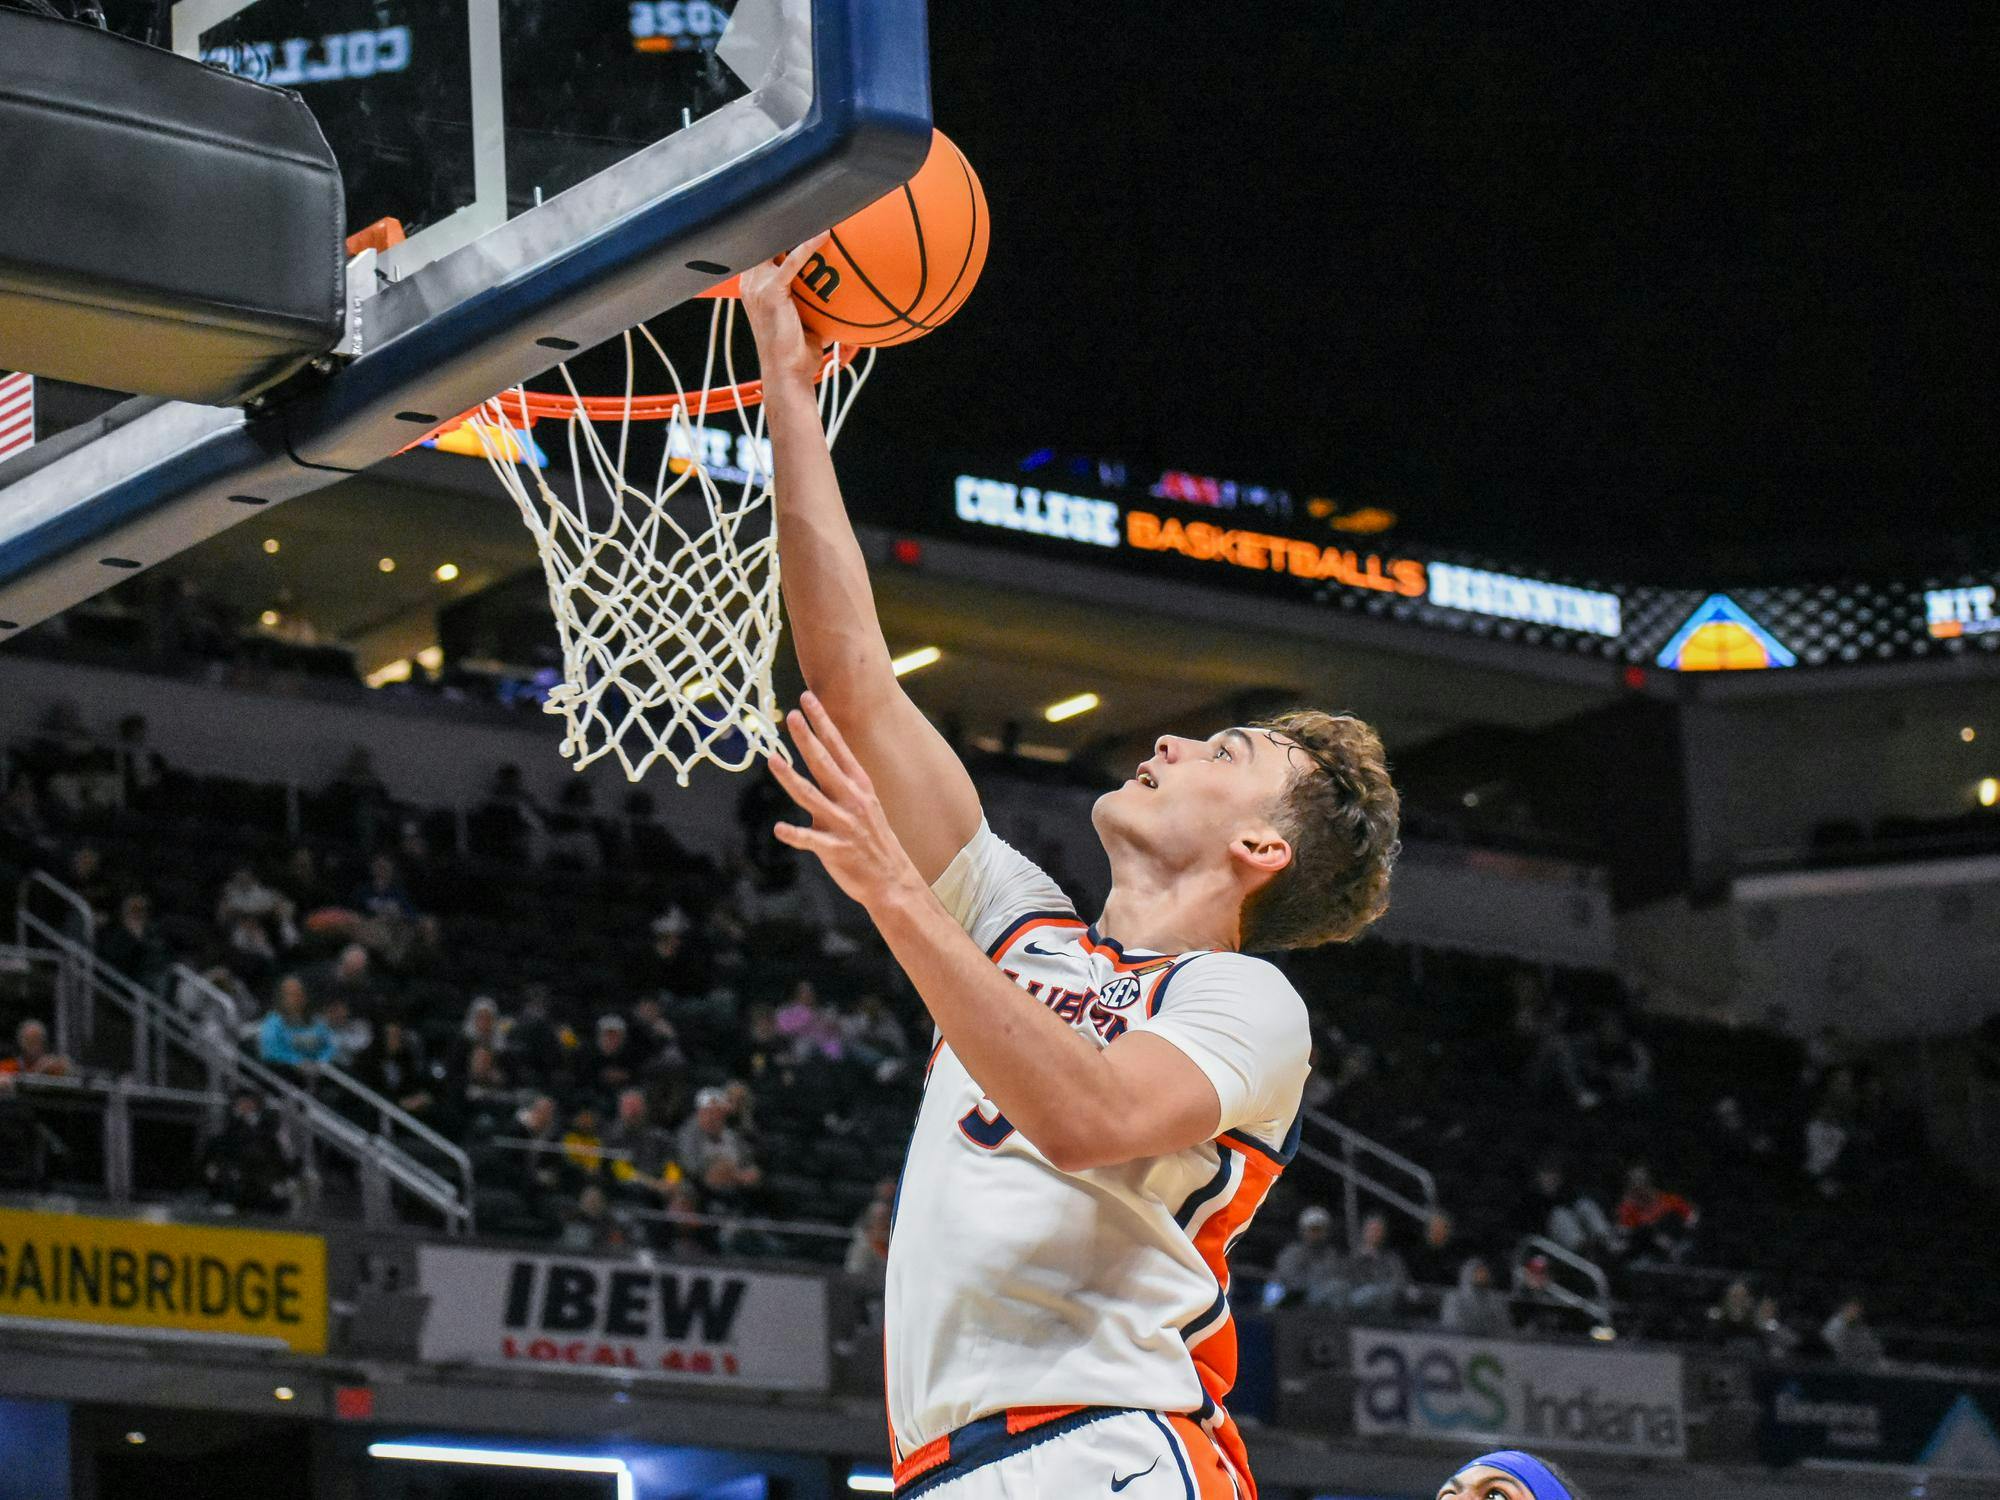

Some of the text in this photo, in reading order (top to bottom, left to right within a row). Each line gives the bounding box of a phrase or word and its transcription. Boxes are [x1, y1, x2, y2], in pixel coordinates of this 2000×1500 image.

[955, 474, 1120, 548] COLLEGE
[1099, 977, 1140, 1009] SEC
[504, 1260, 748, 1344] IBEW
[1364, 1345, 1680, 1448] aes Indiana
